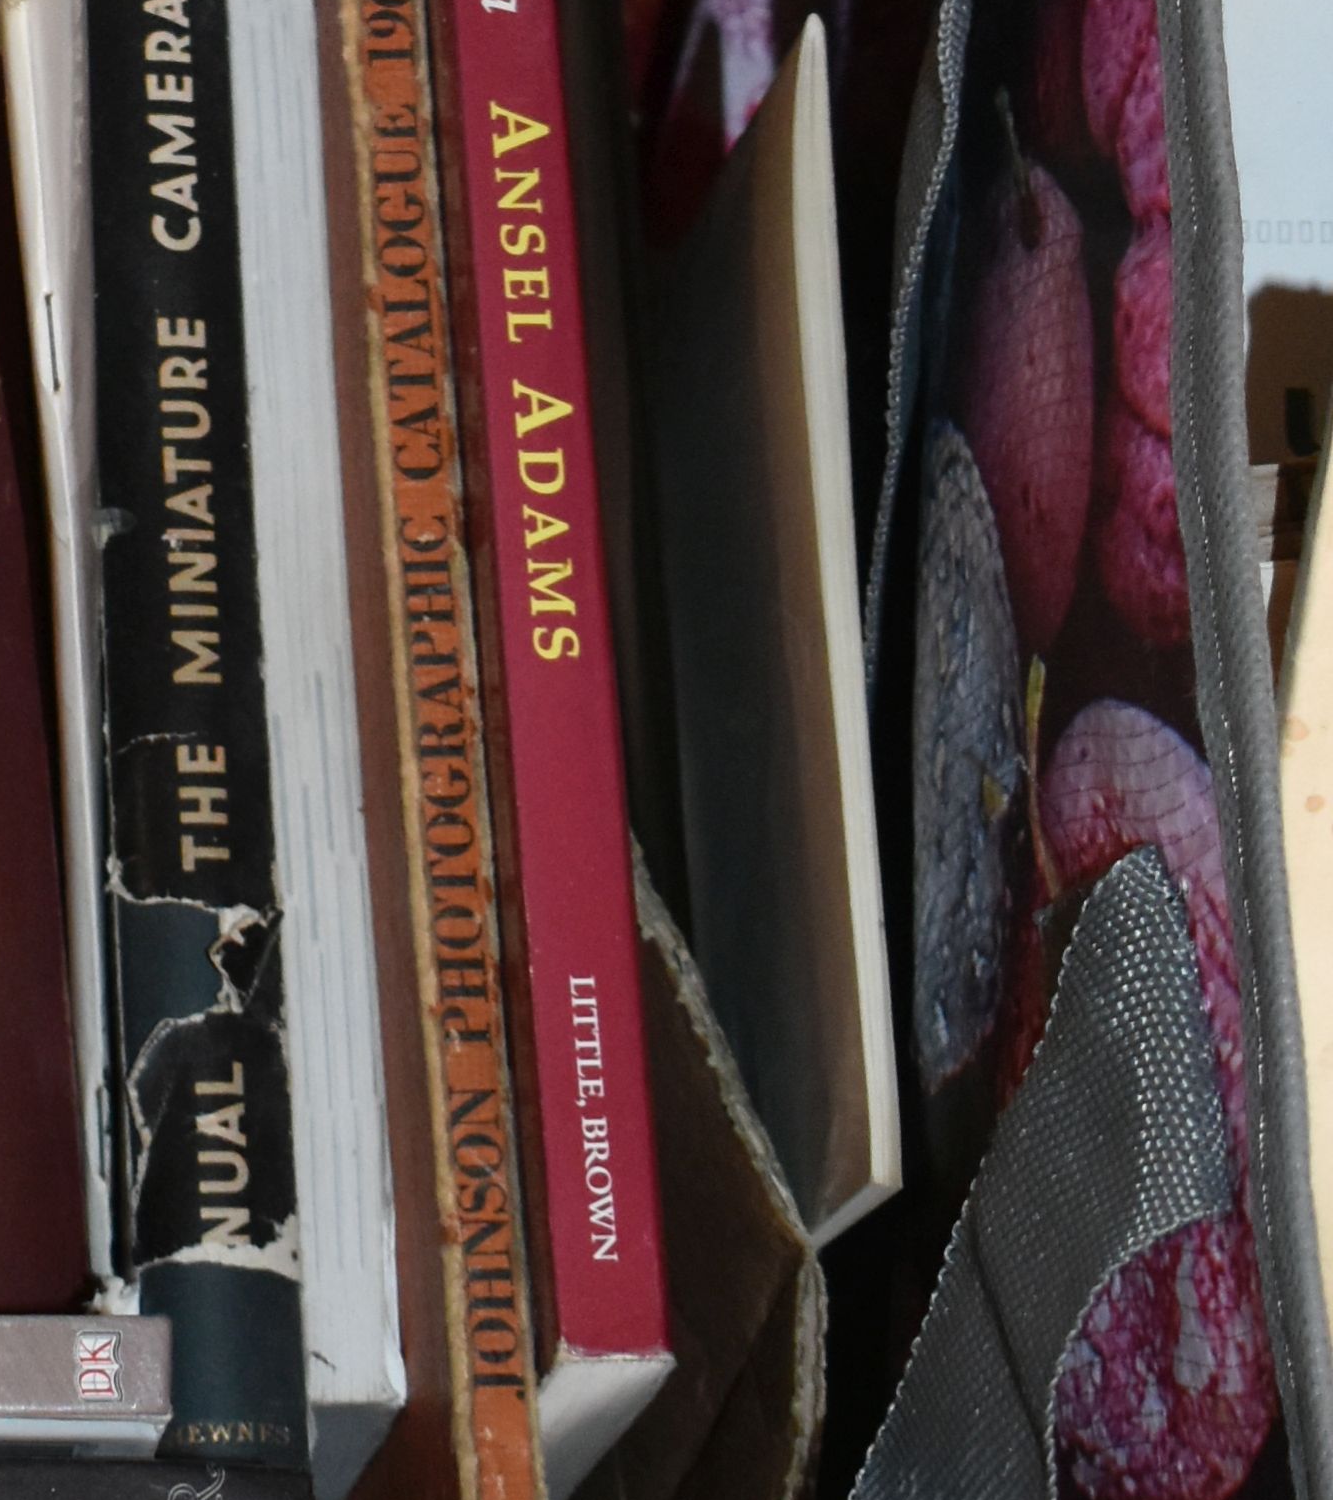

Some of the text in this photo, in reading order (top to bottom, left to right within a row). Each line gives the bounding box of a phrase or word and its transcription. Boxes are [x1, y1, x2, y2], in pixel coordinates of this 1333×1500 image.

[374, 102, 447, 482] CATALOGUE
[488, 100, 581, 662] ANSEL ADAMS
[154, 312, 224, 686] MINIATURE
[176, 740, 231, 873] THE
[399, 512, 496, 1047] PHOTOGRAPHIC
[448, 1085, 528, 1398] JOHNSON
[567, 973, 620, 1264] LITTLE, BROWN
[76, 1336, 118, 1398] DK
